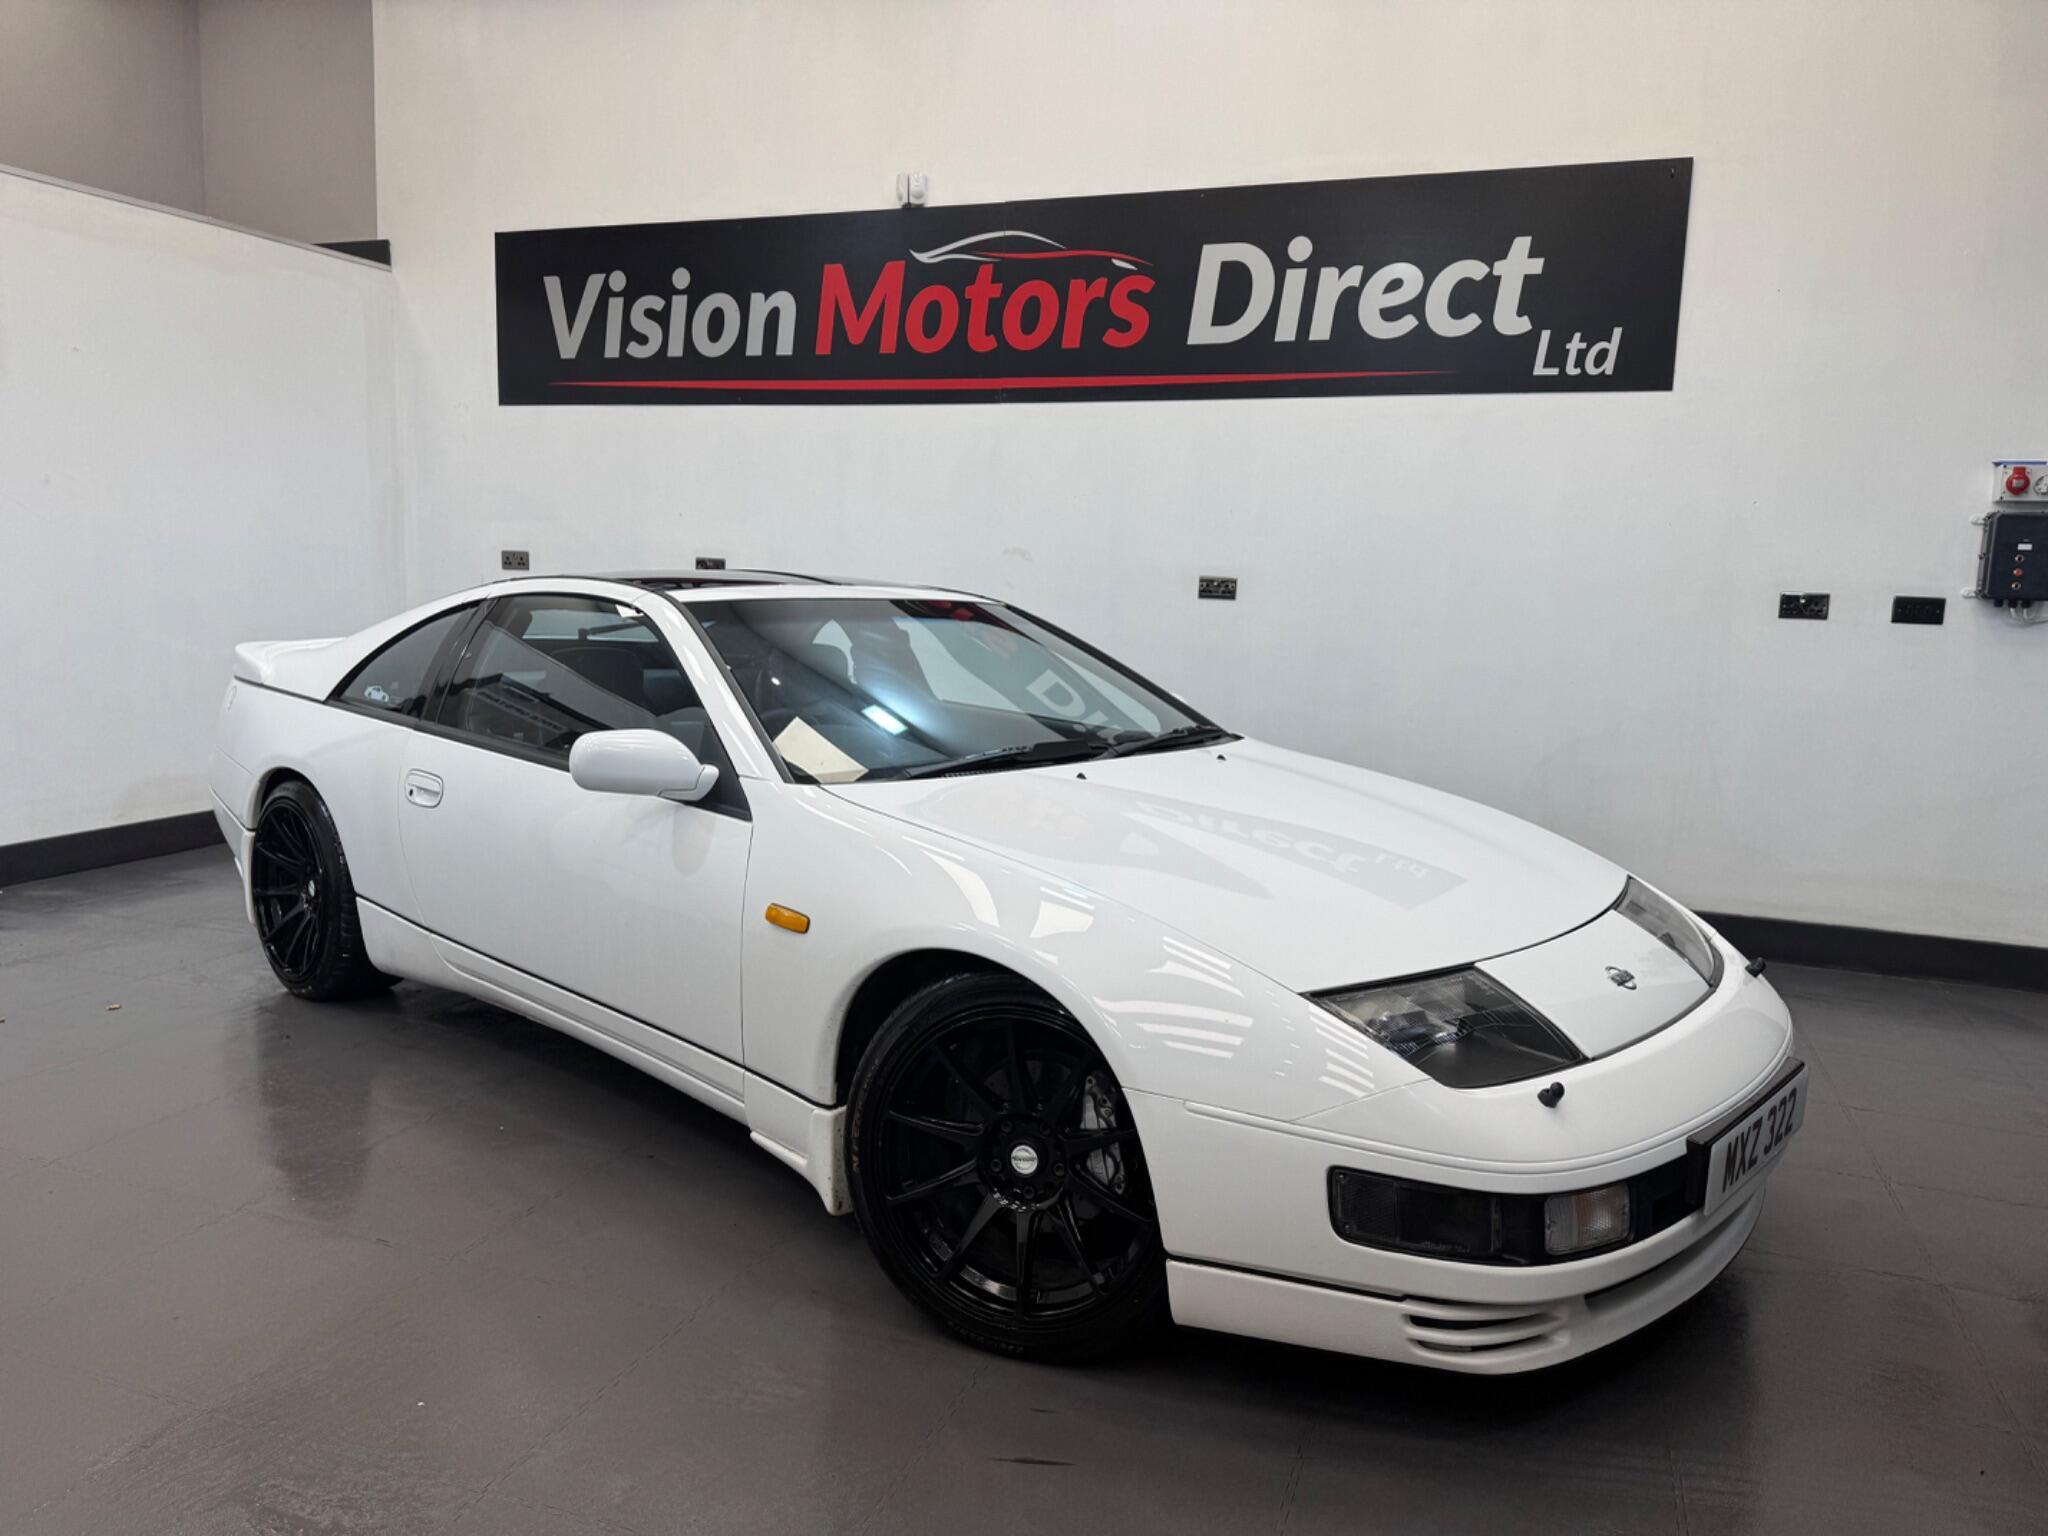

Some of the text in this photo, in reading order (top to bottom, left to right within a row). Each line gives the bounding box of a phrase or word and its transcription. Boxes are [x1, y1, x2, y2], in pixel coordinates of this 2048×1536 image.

[543, 235, 1623, 375] Vision Motors Direct Ltd
[1722, 1087, 1798, 1193] MXZ 322
